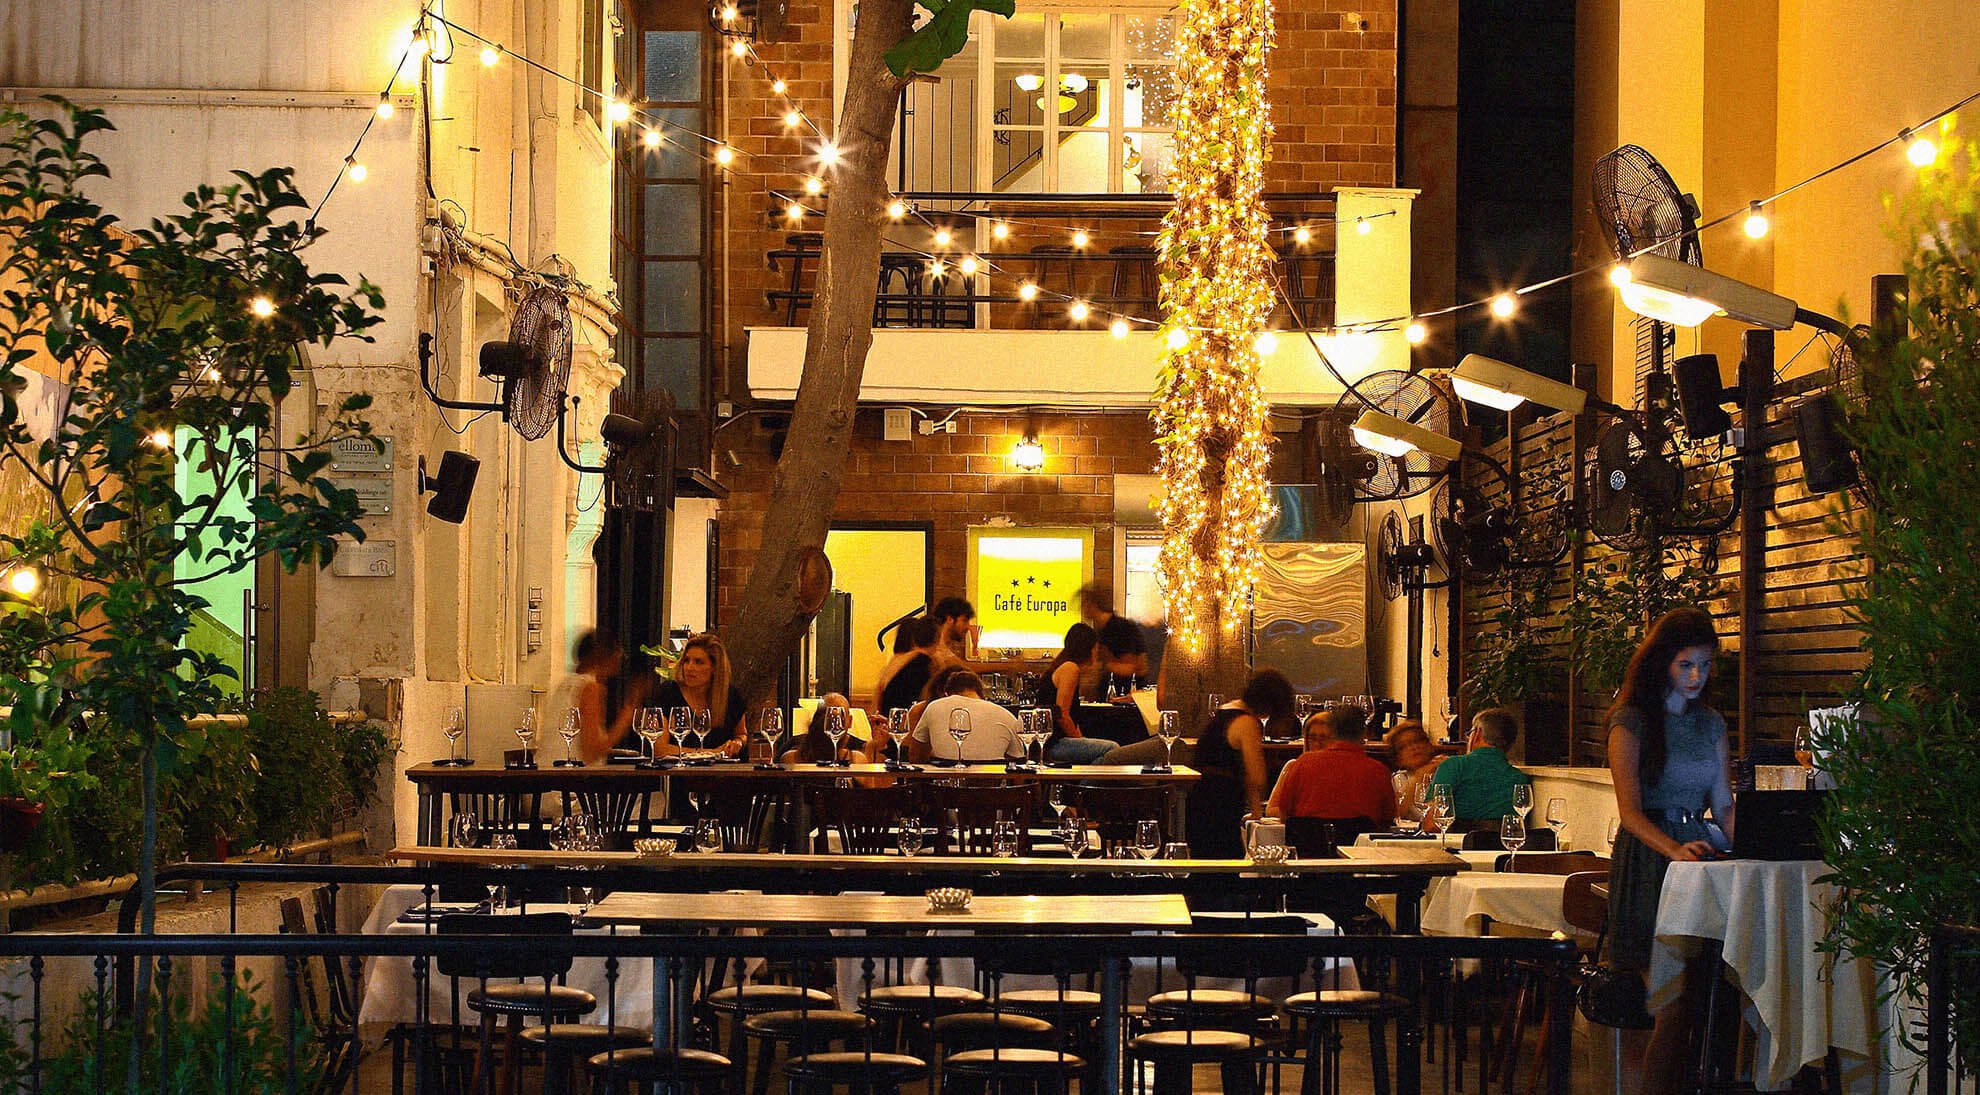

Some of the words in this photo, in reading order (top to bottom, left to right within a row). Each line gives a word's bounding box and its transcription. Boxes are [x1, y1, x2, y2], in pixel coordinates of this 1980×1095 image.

[369, 559, 388, 572] citi
[995, 594, 1022, 611] Café
[1027, 594, 1067, 617] Europa
